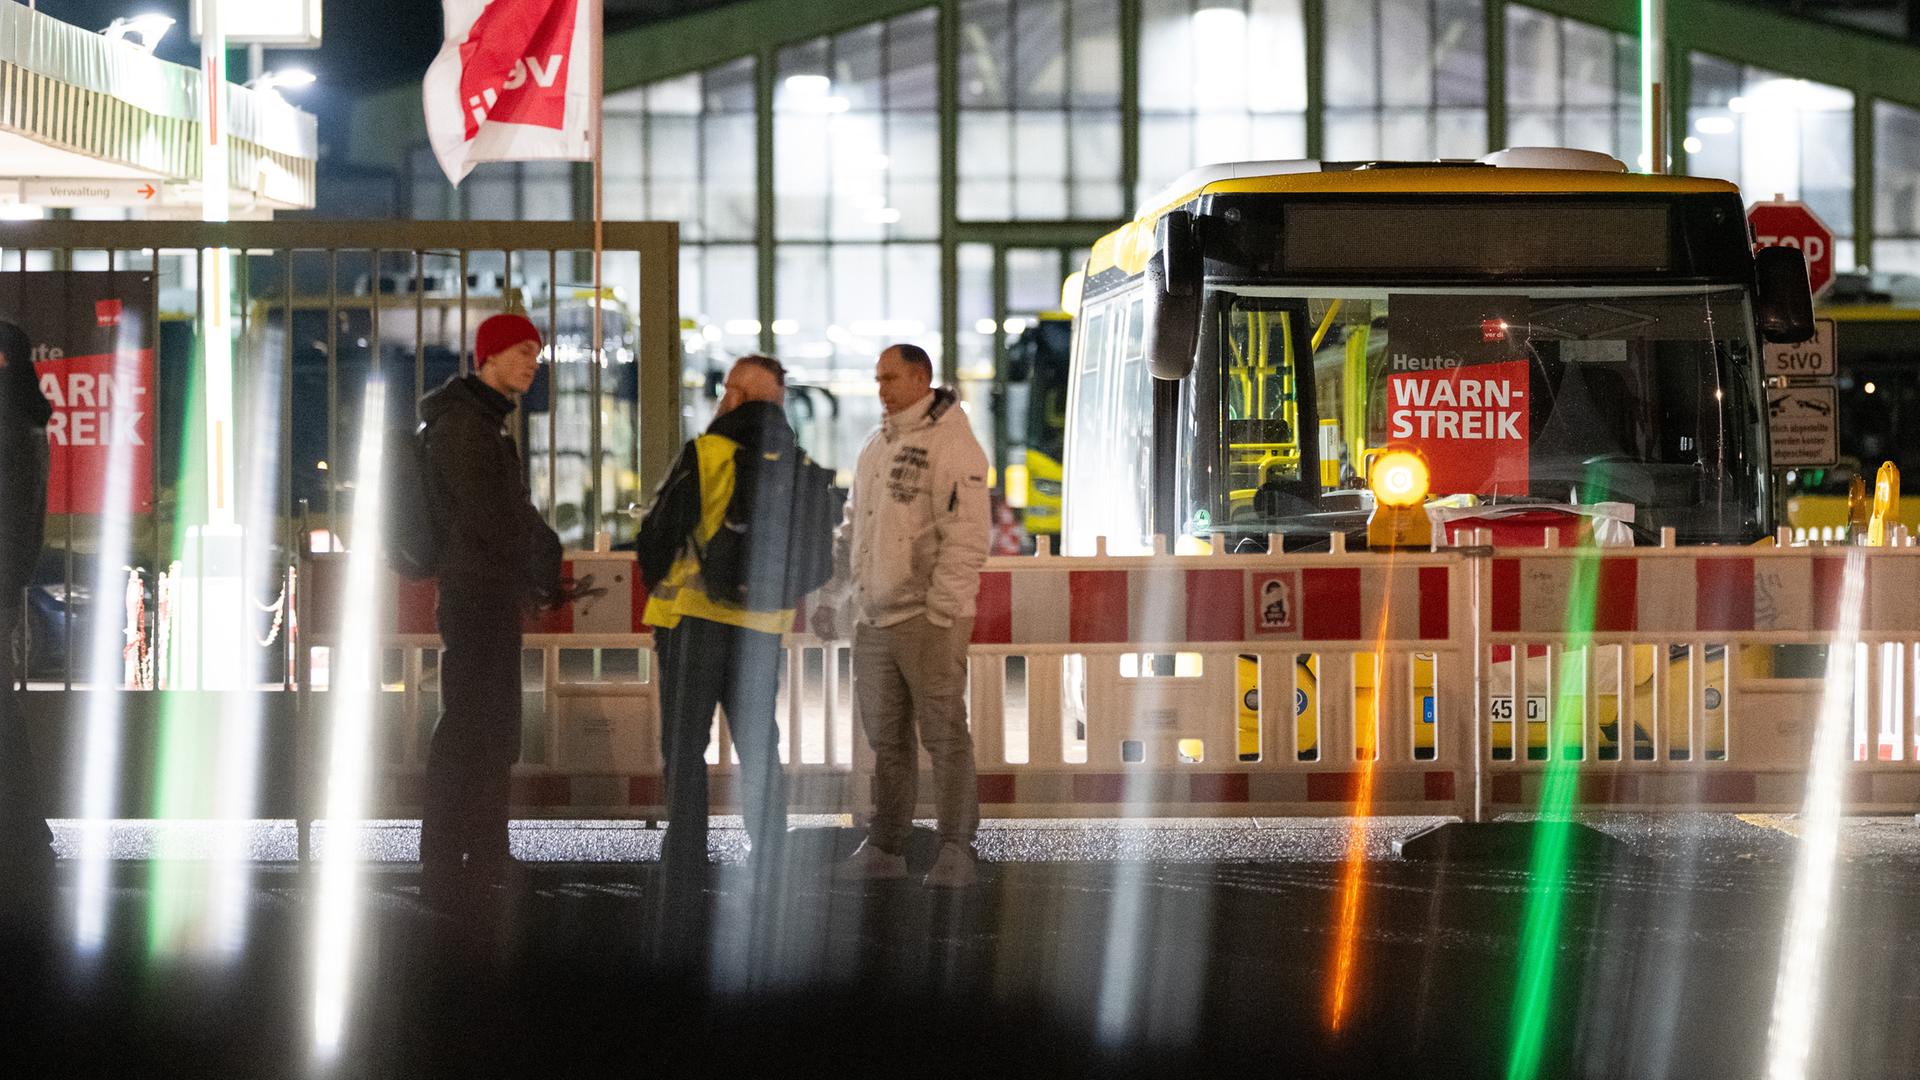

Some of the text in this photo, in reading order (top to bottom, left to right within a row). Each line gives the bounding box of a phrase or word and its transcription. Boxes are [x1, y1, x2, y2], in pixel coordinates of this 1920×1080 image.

[50, 186, 110, 200] Verwaltung
[1393, 354, 1456, 370] Heute
[1777, 352, 1822, 370] StVO
[39, 373, 146, 407] ARN-
[1393, 379, 1523, 407] WARN-
[46, 411, 145, 446] REIK
[1392, 410, 1522, 439] STREIK
[1491, 700, 1538, 719] 450
